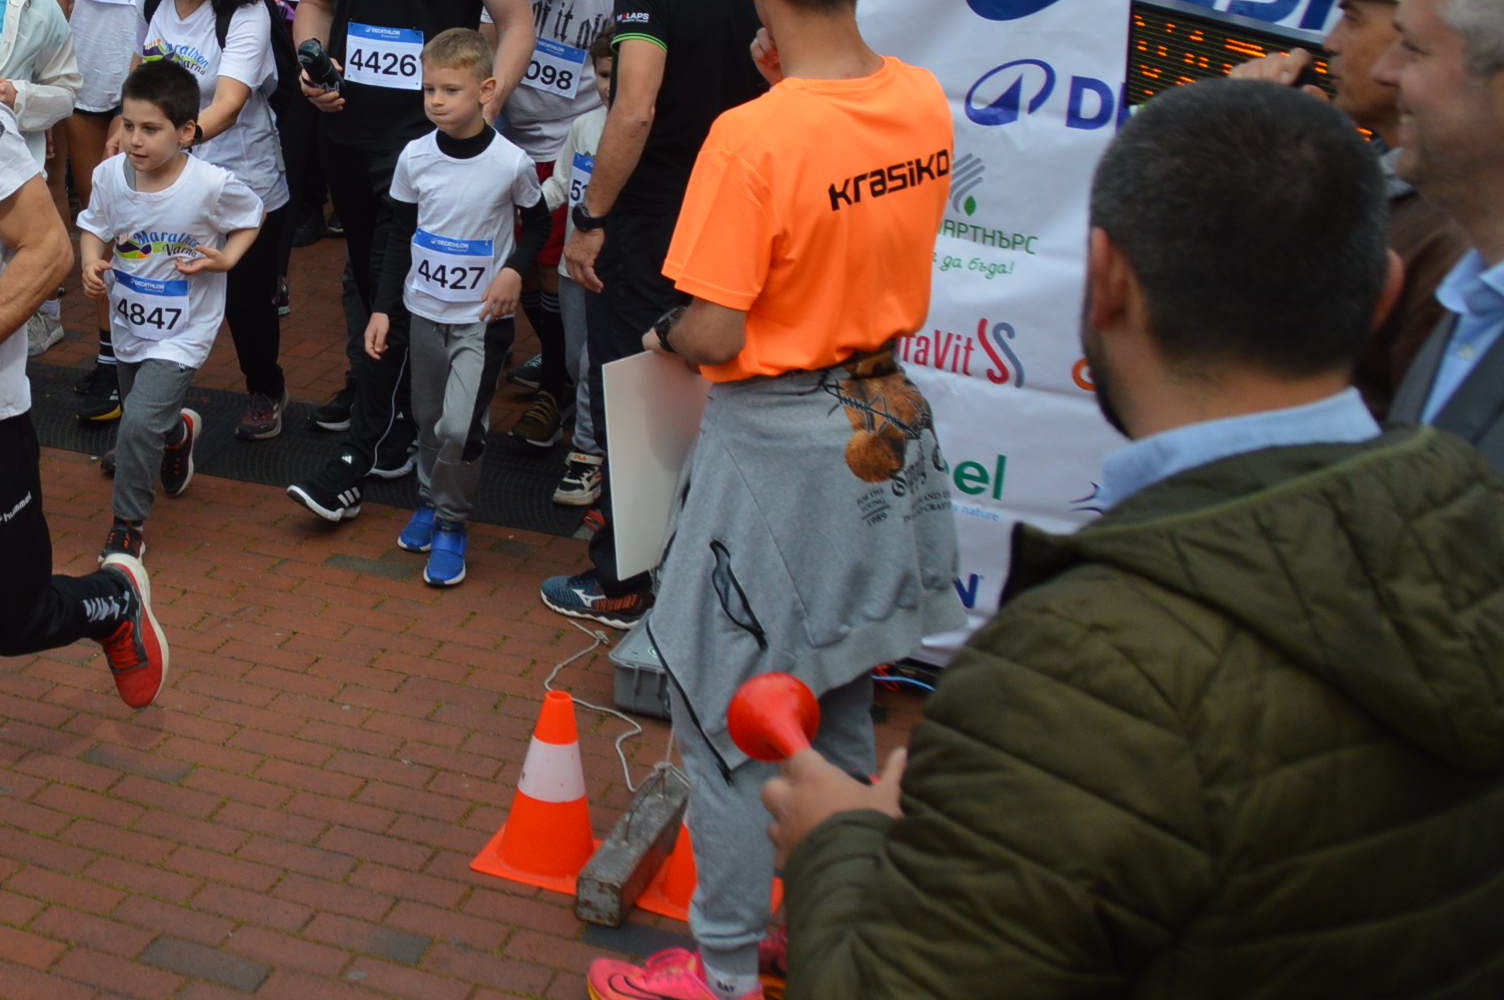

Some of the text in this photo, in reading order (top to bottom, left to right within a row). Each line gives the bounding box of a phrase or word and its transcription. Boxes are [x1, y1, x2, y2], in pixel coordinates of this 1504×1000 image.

[349, 48, 417, 77] 4426
[525, 60, 574, 90] 098
[938, 219, 1039, 255] АРТНЪРС
[417, 259, 486, 290] 4427
[940, 258, 962, 272] да
[116, 298, 182, 331] 4847
[896, 329, 976, 377] raVit
